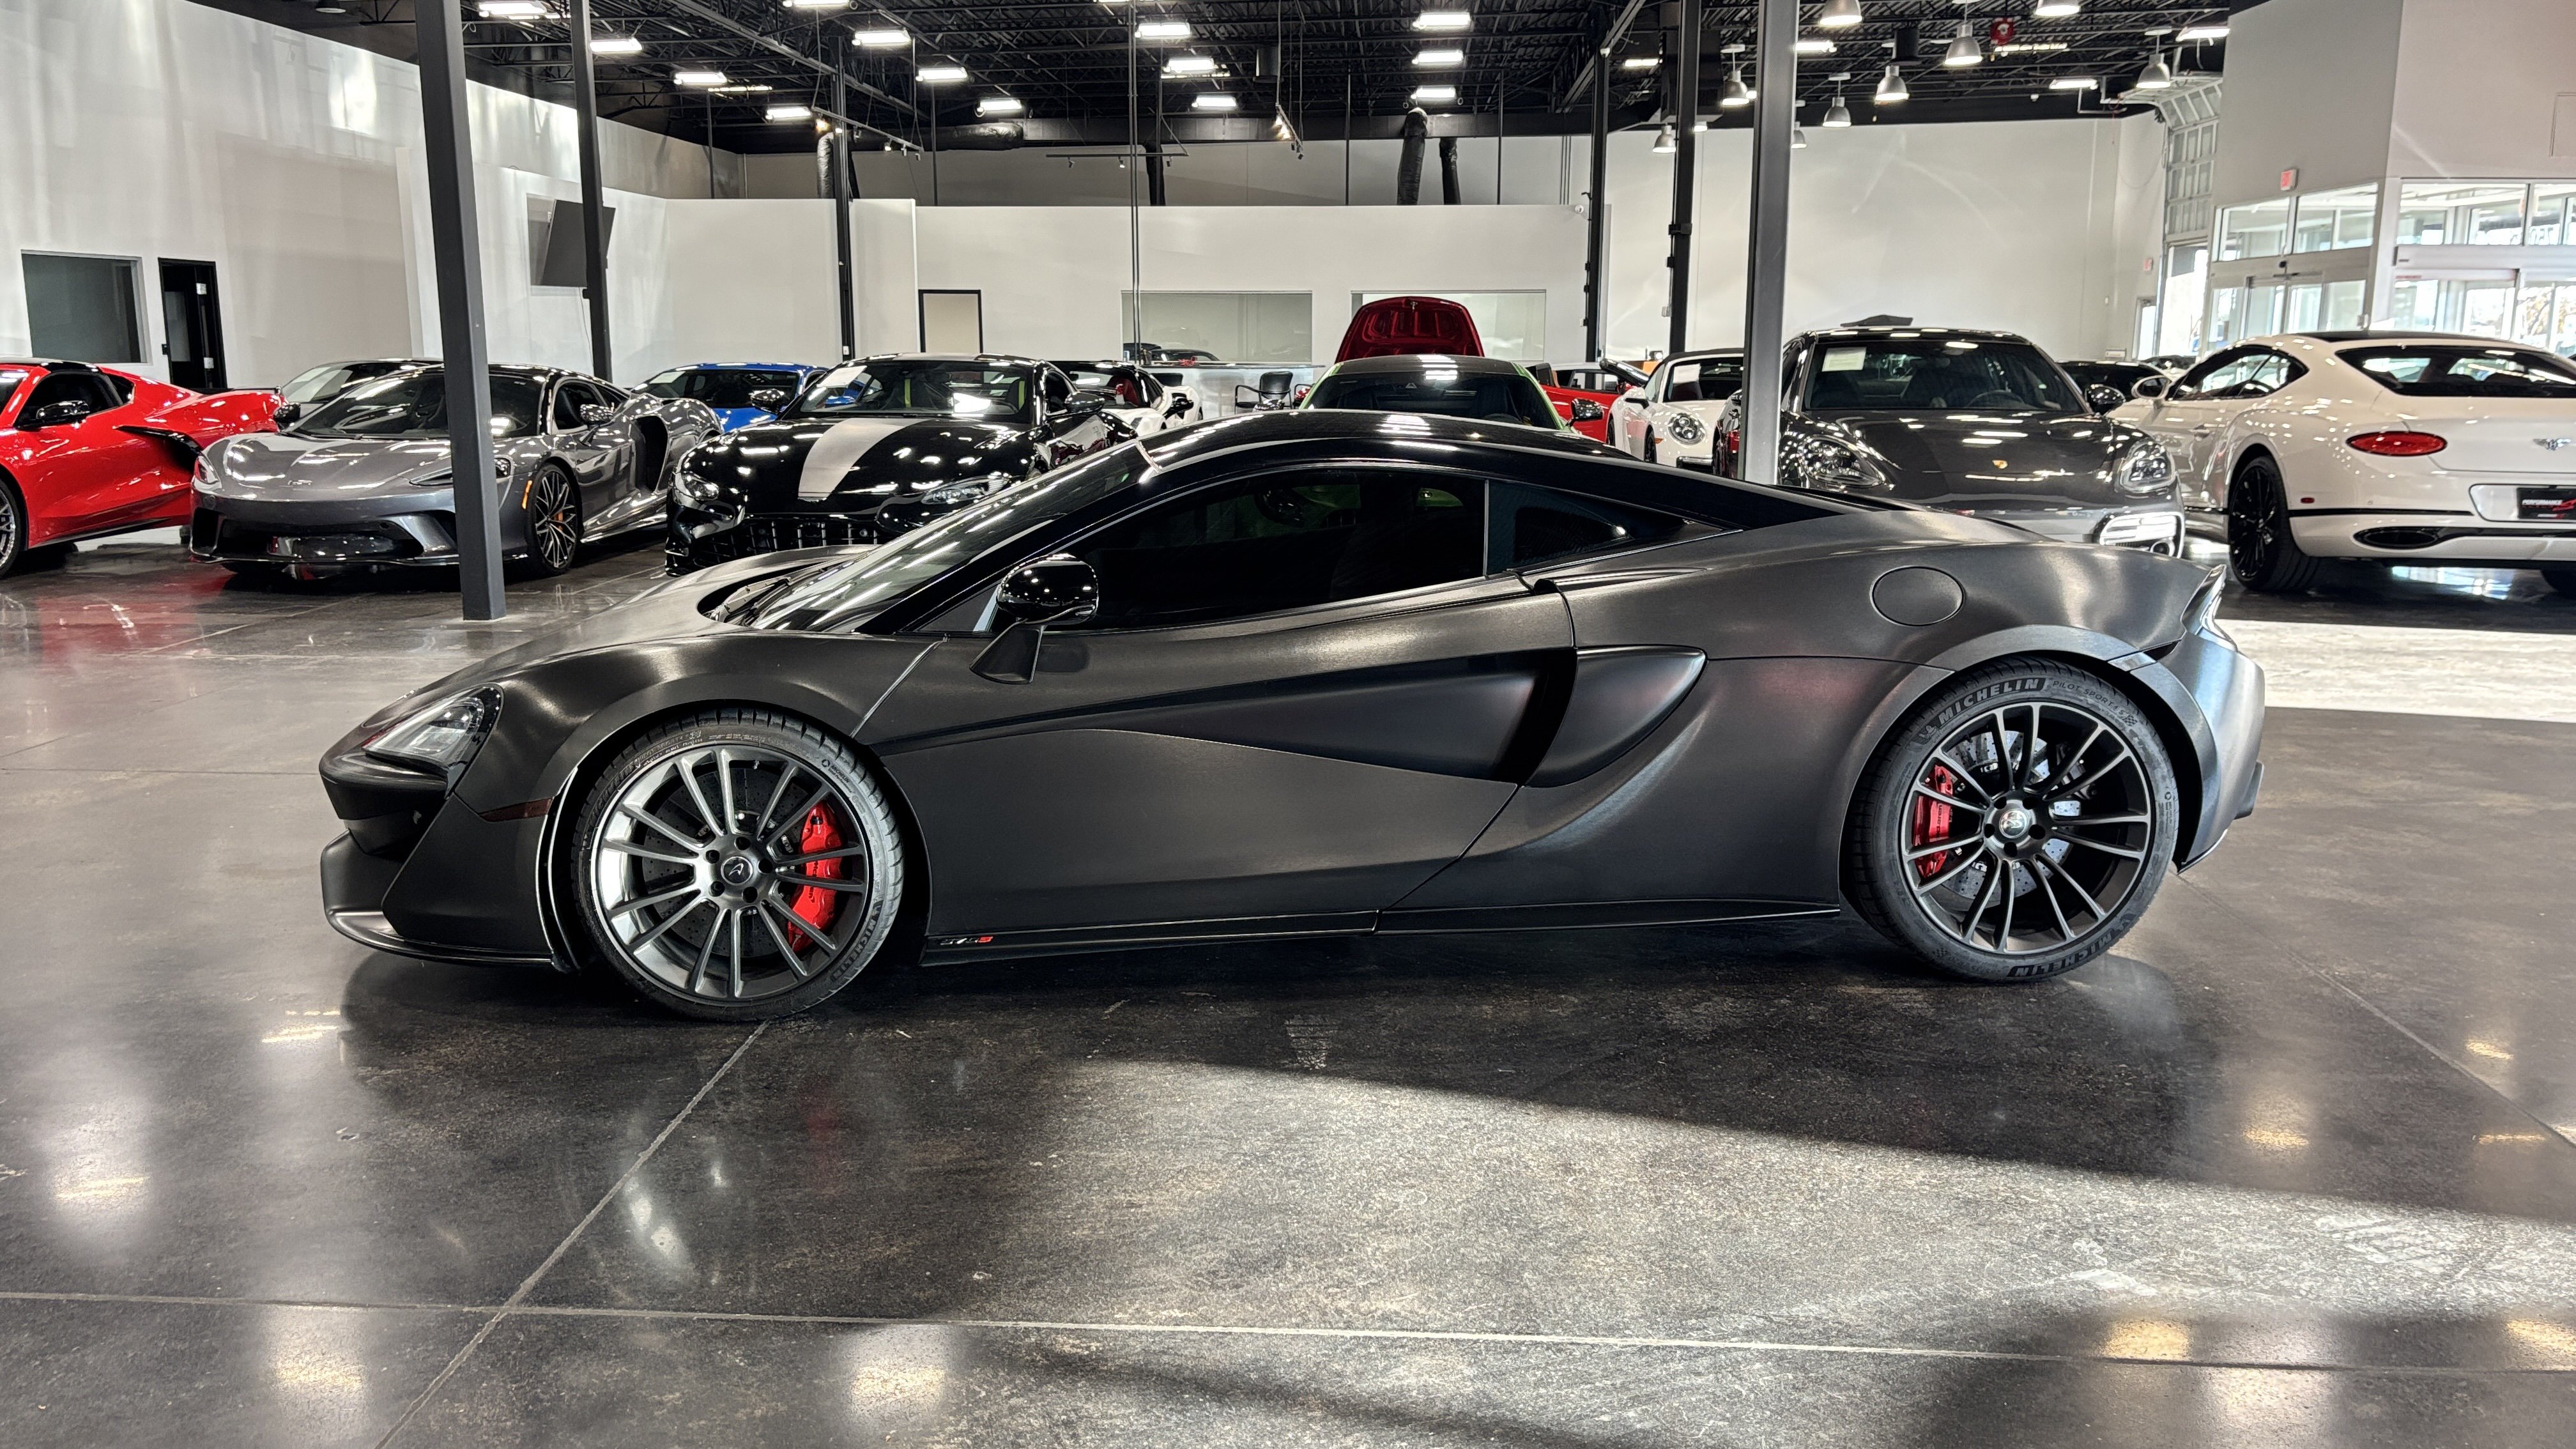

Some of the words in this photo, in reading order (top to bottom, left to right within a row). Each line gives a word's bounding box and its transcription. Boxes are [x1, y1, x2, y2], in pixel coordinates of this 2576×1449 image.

[1938, 678, 2039, 724] MICHELIN
[2053, 680, 2081, 691] PILOT
[2083, 689, 2113, 706] SPORT
[831, 765, 850, 783] MICHELIN
[809, 861, 818, 899] McLen
[833, 919, 876, 979] MICHELIN
[2014, 932, 2112, 977] MICHELIN
